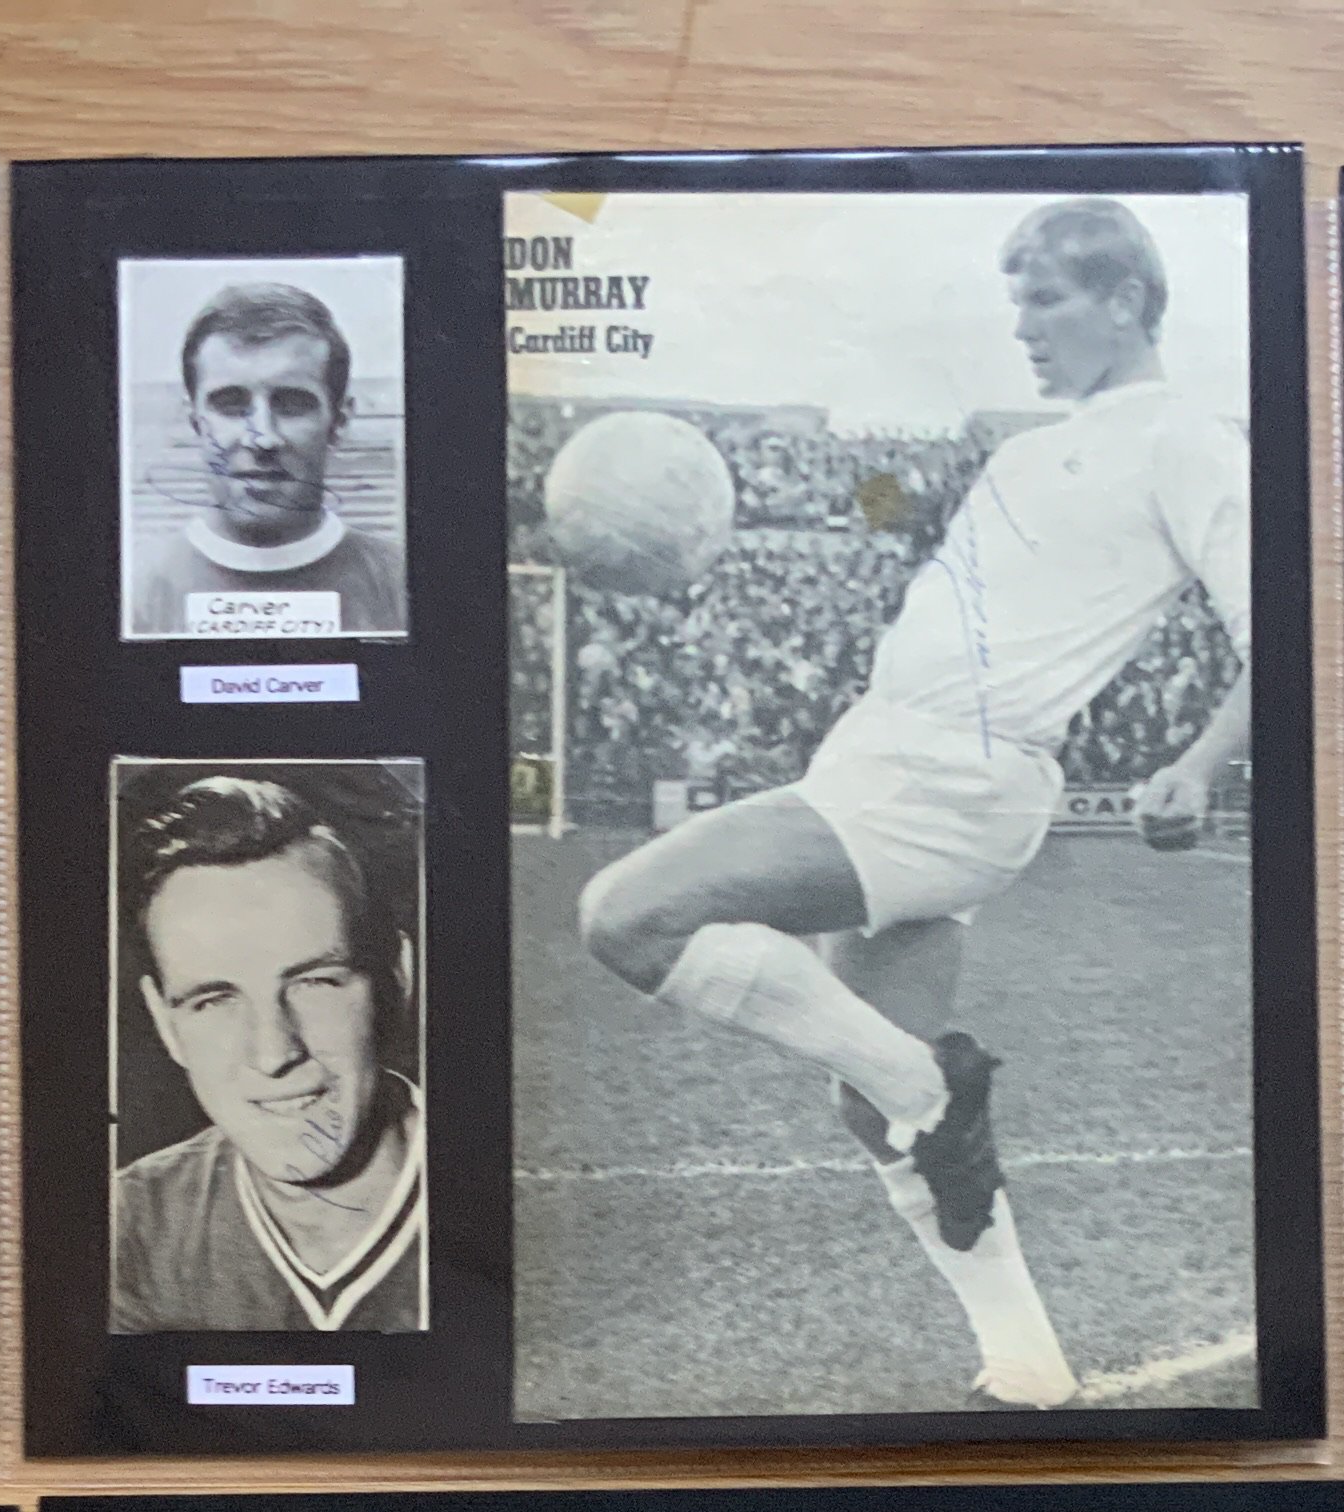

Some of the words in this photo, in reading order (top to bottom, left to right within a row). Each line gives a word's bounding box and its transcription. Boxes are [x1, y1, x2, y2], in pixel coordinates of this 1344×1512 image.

[503, 235, 574, 272] DON
[505, 275, 652, 312] MURRAY
[508, 325, 597, 355] Cardiff
[605, 324, 655, 359] City
[208, 597, 291, 616] Carver
[211, 677, 262, 694] David
[265, 676, 325, 694] Carver
[202, 1377, 262, 1395] Trevor
[267, 1377, 342, 1395] Edwards
